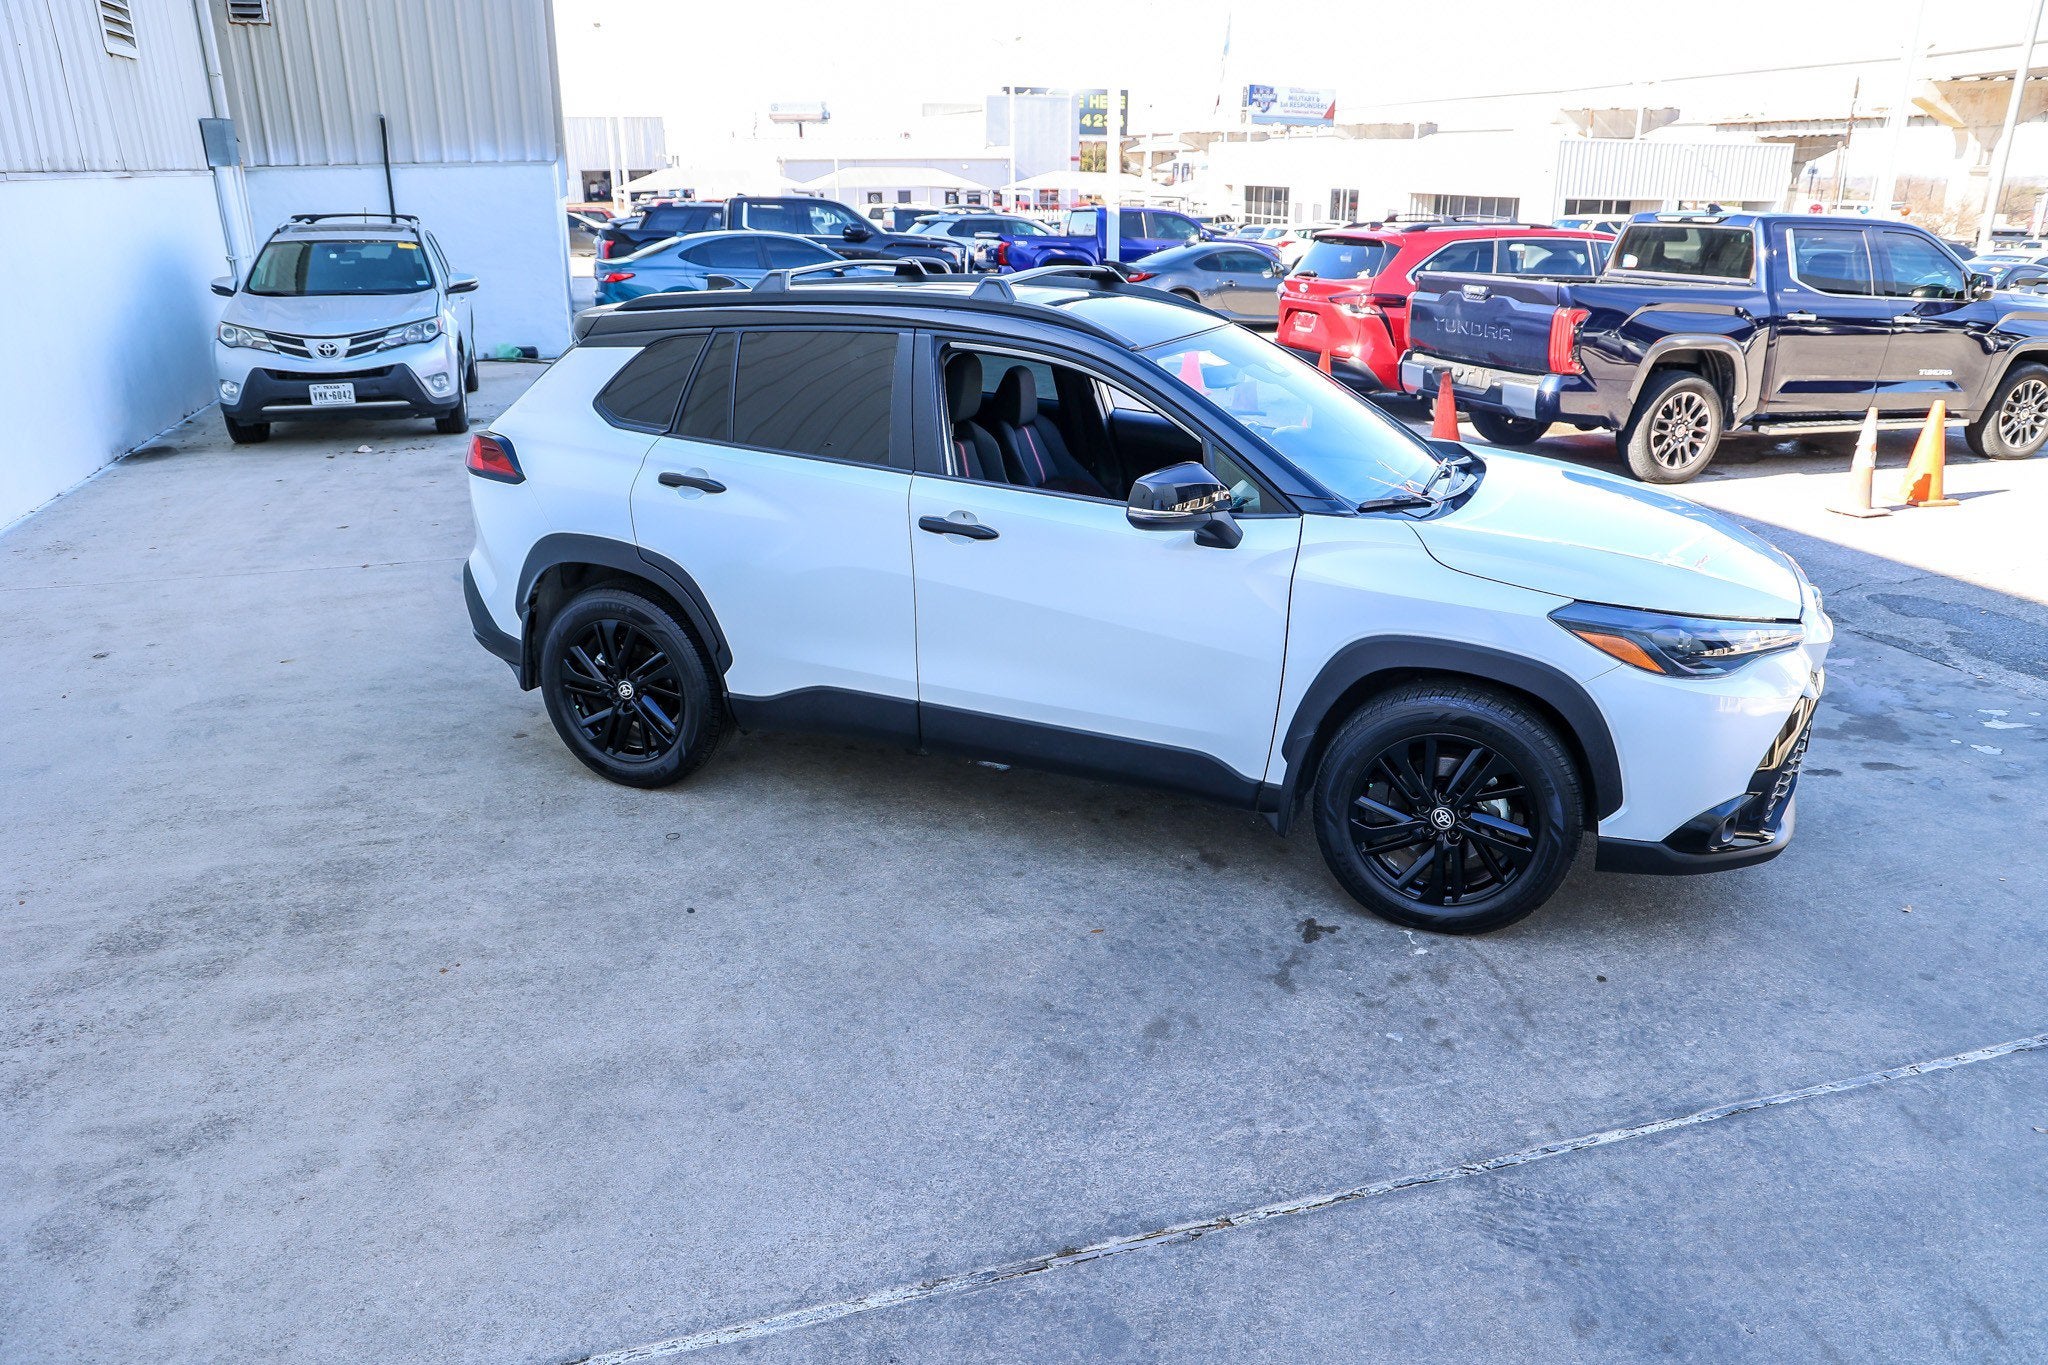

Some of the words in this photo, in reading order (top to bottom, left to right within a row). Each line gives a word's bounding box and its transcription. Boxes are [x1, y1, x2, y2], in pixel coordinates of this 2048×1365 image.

[1089, 95, 1126, 109] HEE
[1433, 316, 1513, 341] TUNDRA
[1918, 368, 1953, 376] TUNDRA
